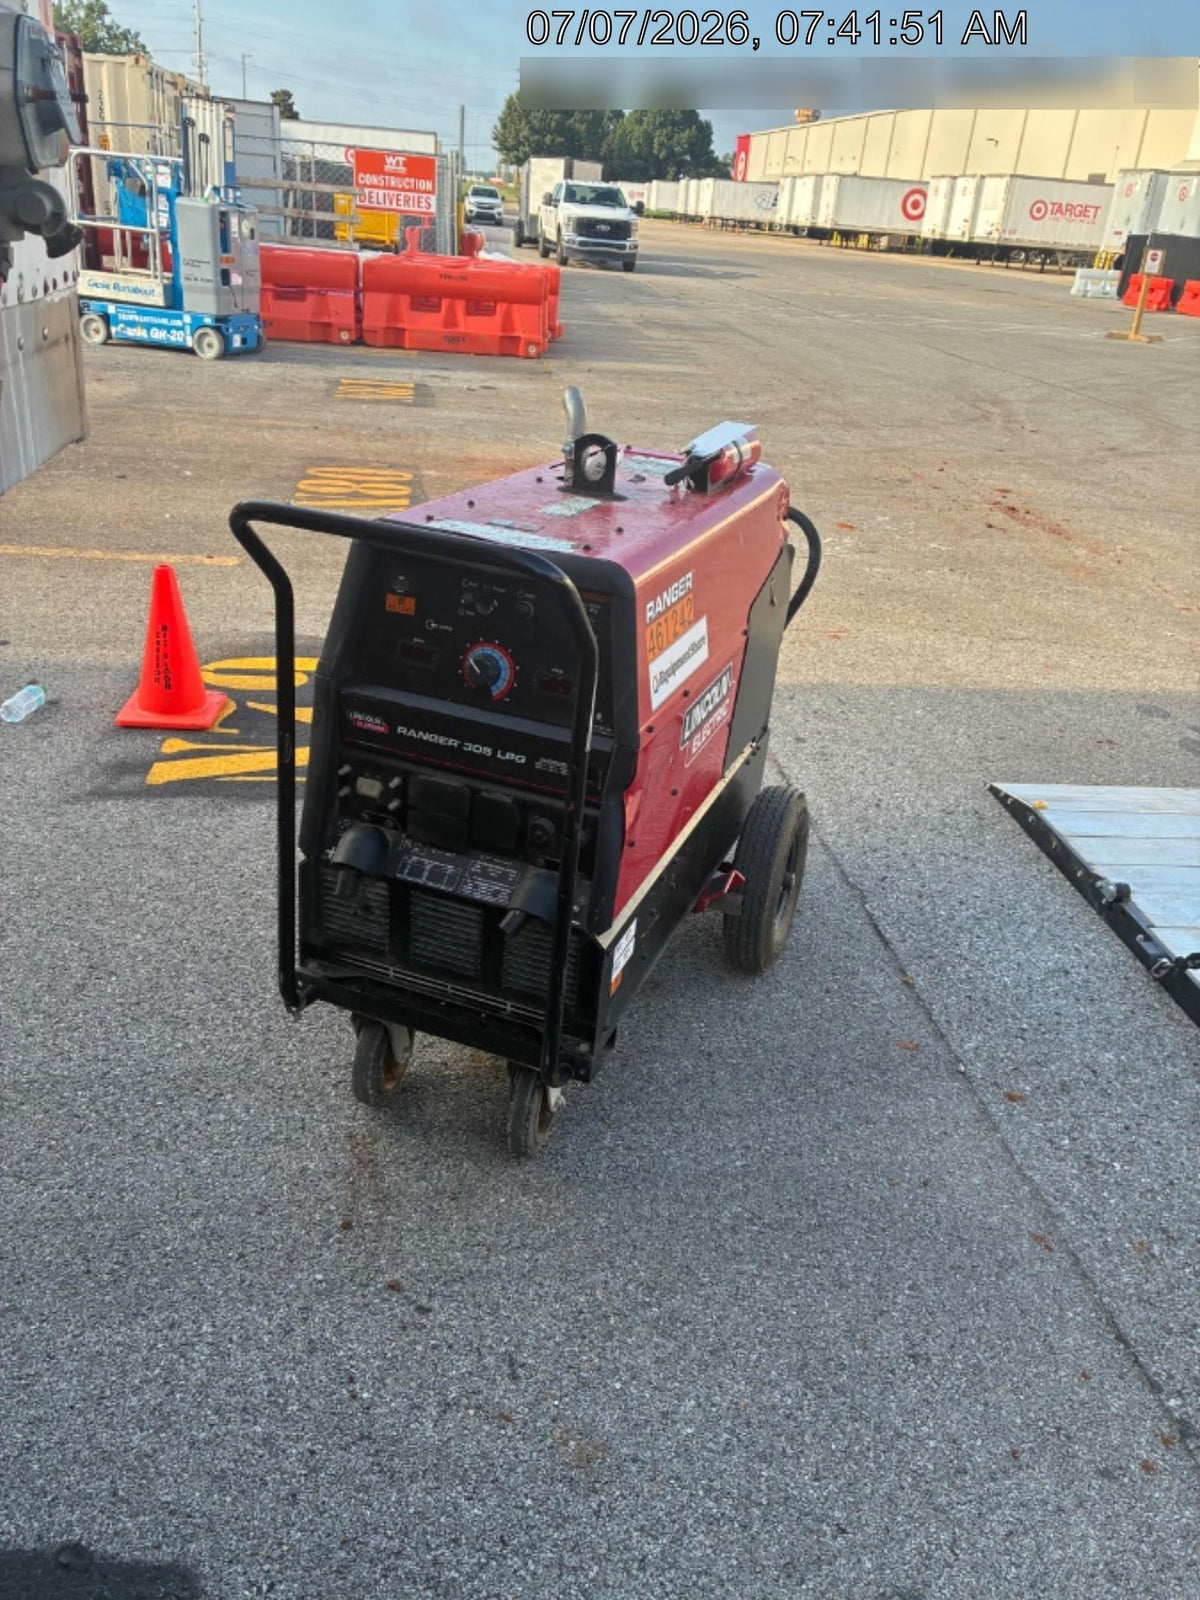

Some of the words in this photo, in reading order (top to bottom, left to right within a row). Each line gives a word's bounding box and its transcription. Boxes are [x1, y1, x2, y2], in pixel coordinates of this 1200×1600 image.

[358, 172, 433, 191] CONSTRUCTION
[359, 191, 432, 210] DELIVERIES
[1050, 202, 1102, 220] TARGET
[646, 571, 693, 624] RANGER
[648, 596, 693, 657] 461242
[684, 668, 733, 741] LINCOLN
[396, 725, 460, 748] RANGER
[462, 741, 493, 757] 305
[496, 749, 526, 764] LPG
